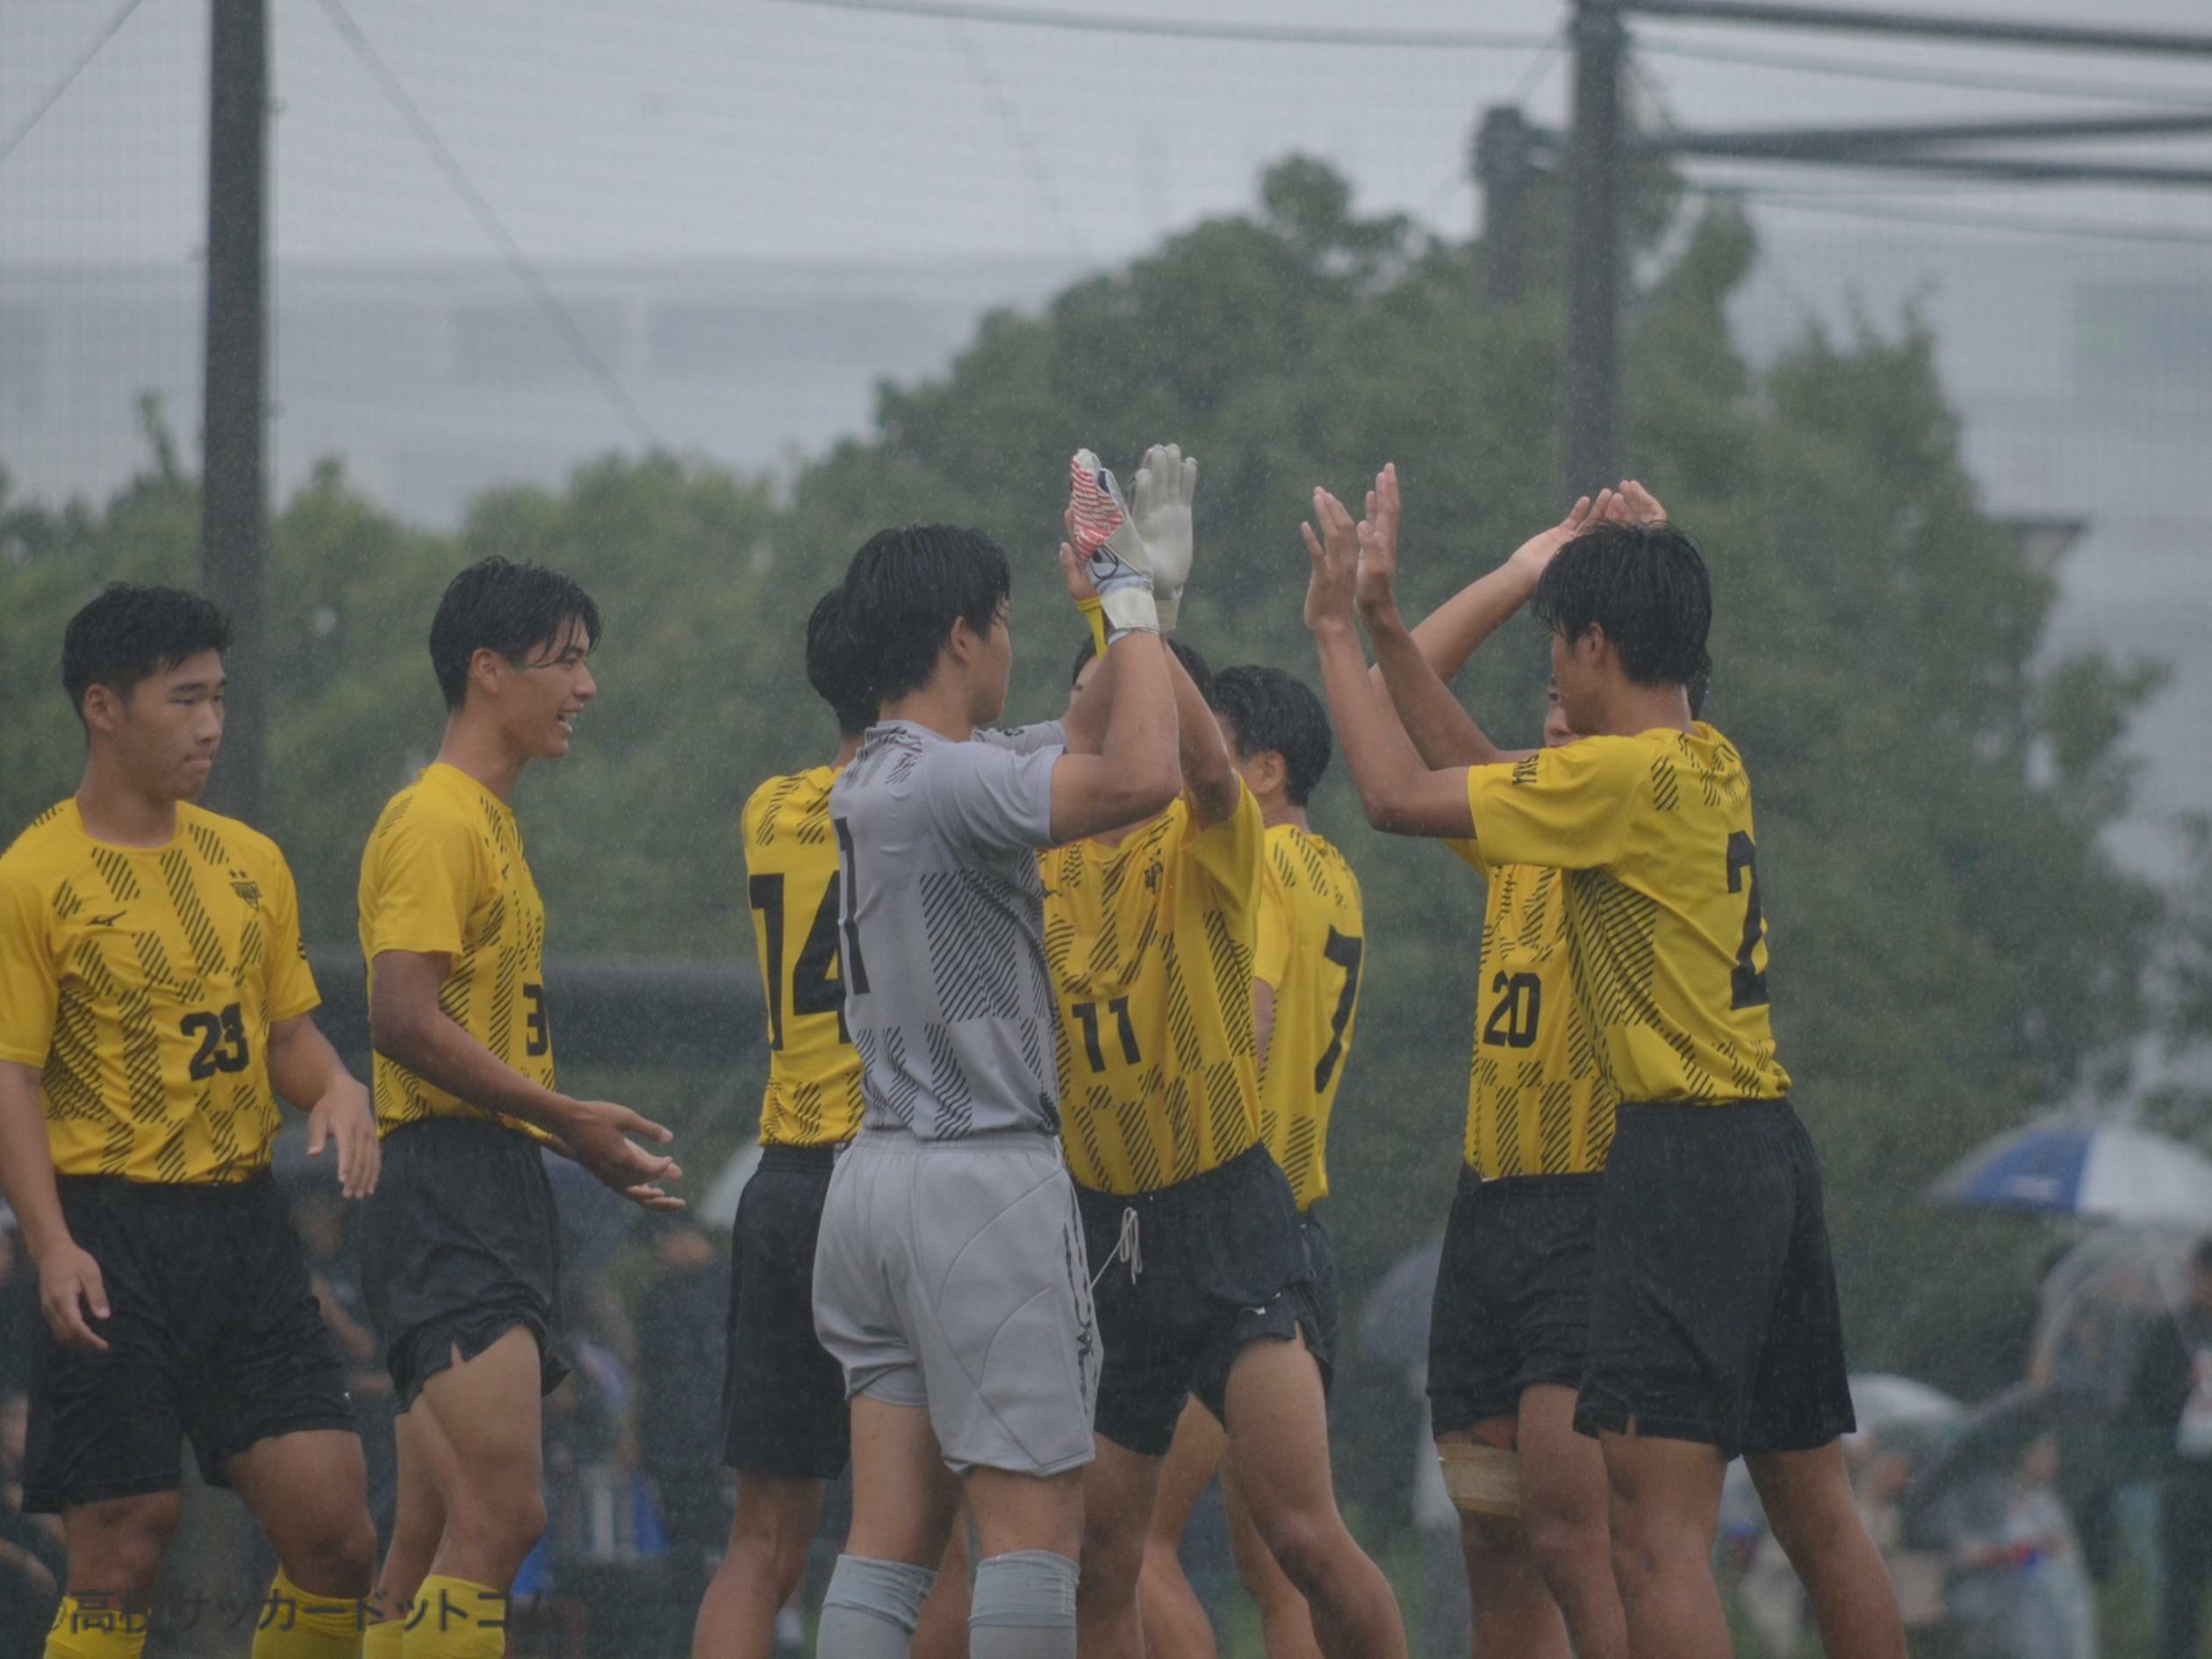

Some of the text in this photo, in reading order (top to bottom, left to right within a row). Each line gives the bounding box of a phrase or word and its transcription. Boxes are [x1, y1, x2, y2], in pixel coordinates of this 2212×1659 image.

[749, 871, 851, 1051] 14
[834, 816, 870, 995] 1
[1726, 830, 1770, 1011] 2
[180, 1002, 250, 1081] 23
[522, 982, 549, 1057] 3
[1071, 995, 1142, 1074] 11
[1314, 924, 1362, 1095] 7
[1483, 969, 1541, 1049] 20
